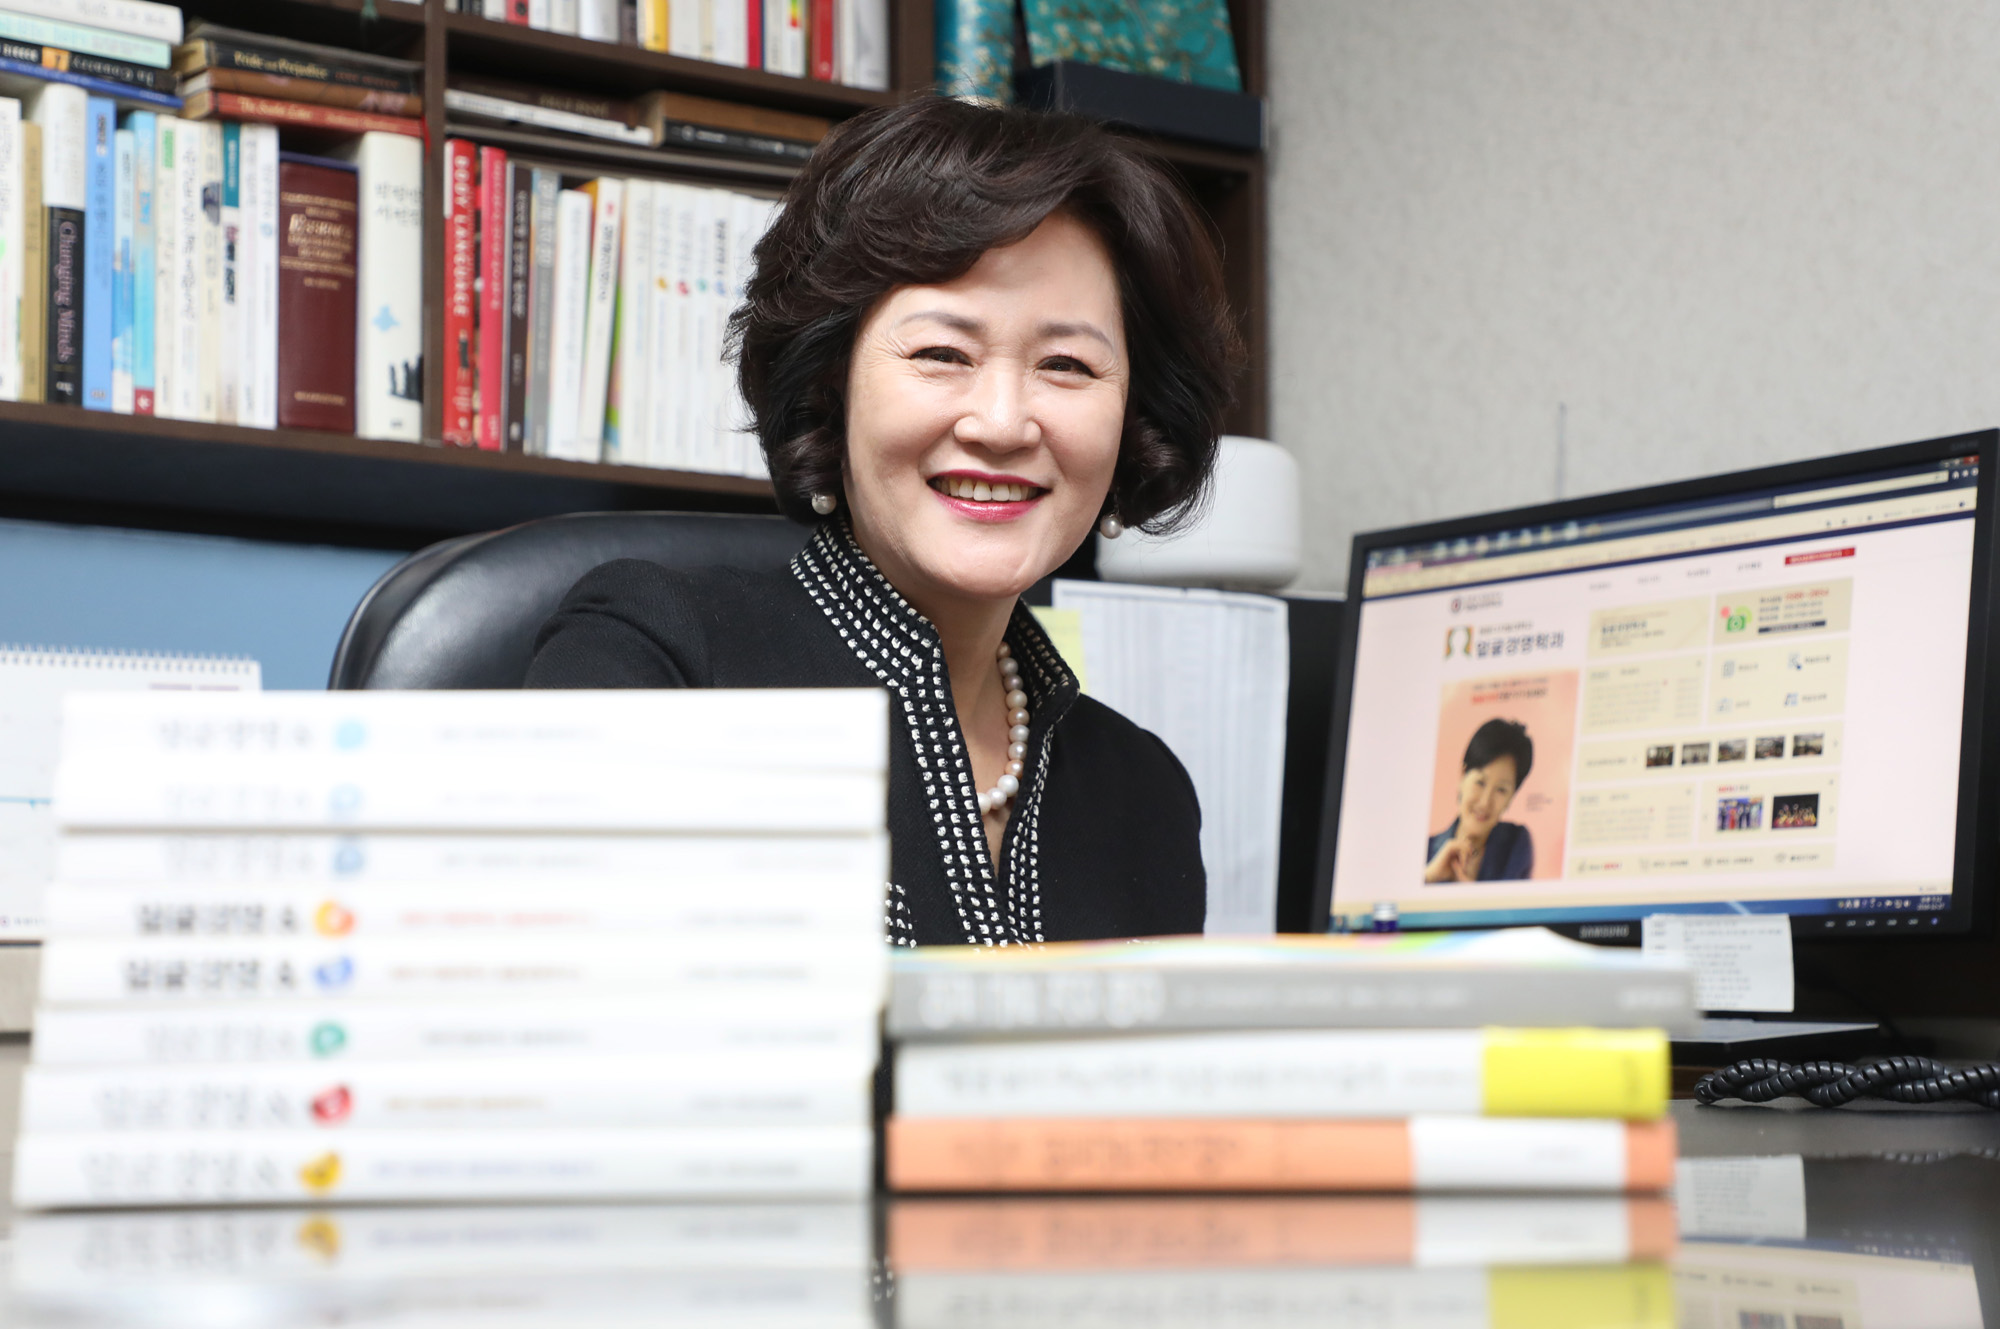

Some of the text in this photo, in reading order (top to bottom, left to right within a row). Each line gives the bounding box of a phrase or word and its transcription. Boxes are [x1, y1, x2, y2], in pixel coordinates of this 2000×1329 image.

[233, 51, 264, 70] Pride
[277, 58, 328, 80] Prejudice
[452, 154, 471, 317] BODY LANGUAGE
[53, 221, 77, 363] Changing Minds
[1477, 631, 1565, 659] 얼굴경영학과
[1579, 925, 1630, 939] SAMSUNG
